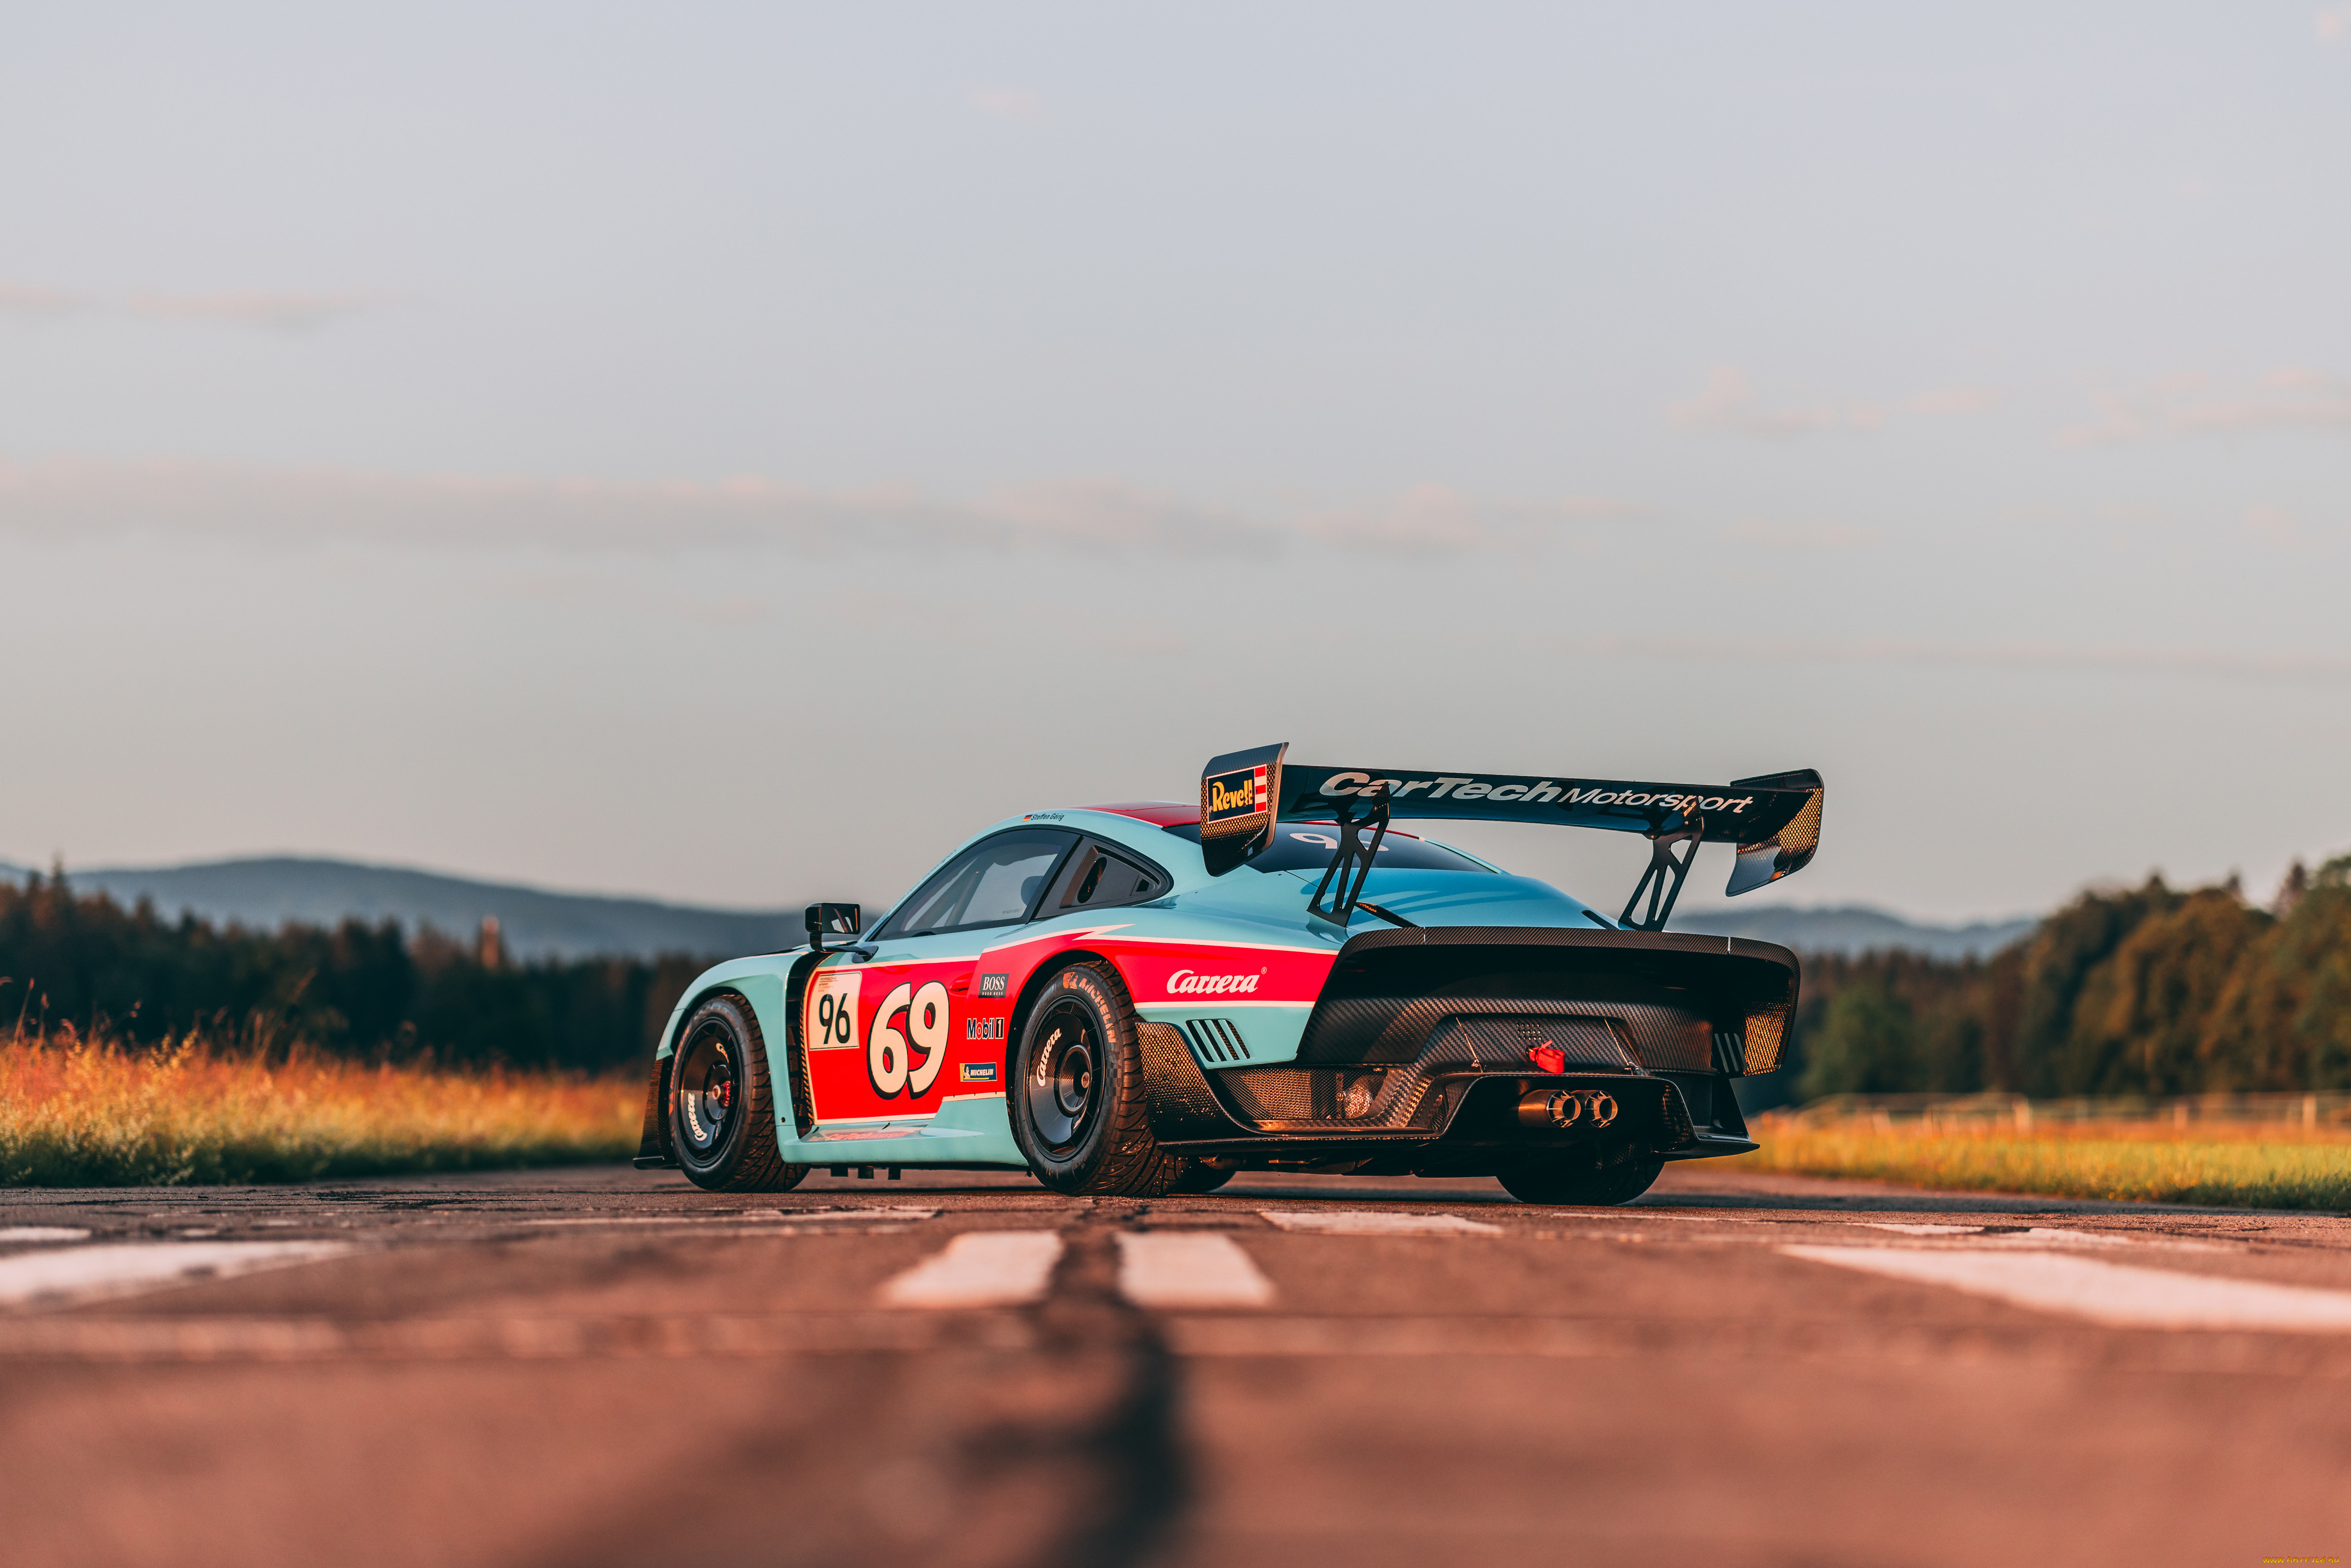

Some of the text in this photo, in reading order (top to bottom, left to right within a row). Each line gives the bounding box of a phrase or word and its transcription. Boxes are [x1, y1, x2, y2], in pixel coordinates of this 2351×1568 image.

[1212, 779, 1253, 812] Revell
[1319, 772, 1562, 803] CarTech
[1557, 788, 1753, 813] Motorsport
[1050, 813, 1065, 822] Görig
[983, 976, 1005, 991] BOSS
[819, 993, 850, 1044] 96
[967, 1018, 995, 1040] Mobil
[1079, 977, 1116, 1043] MICHELIN
[866, 980, 950, 1100] 69
[1036, 1028, 1062, 1087] Carrera
[970, 1068, 994, 1076] MICHELIN
[688, 1093, 708, 1141] Carrera
